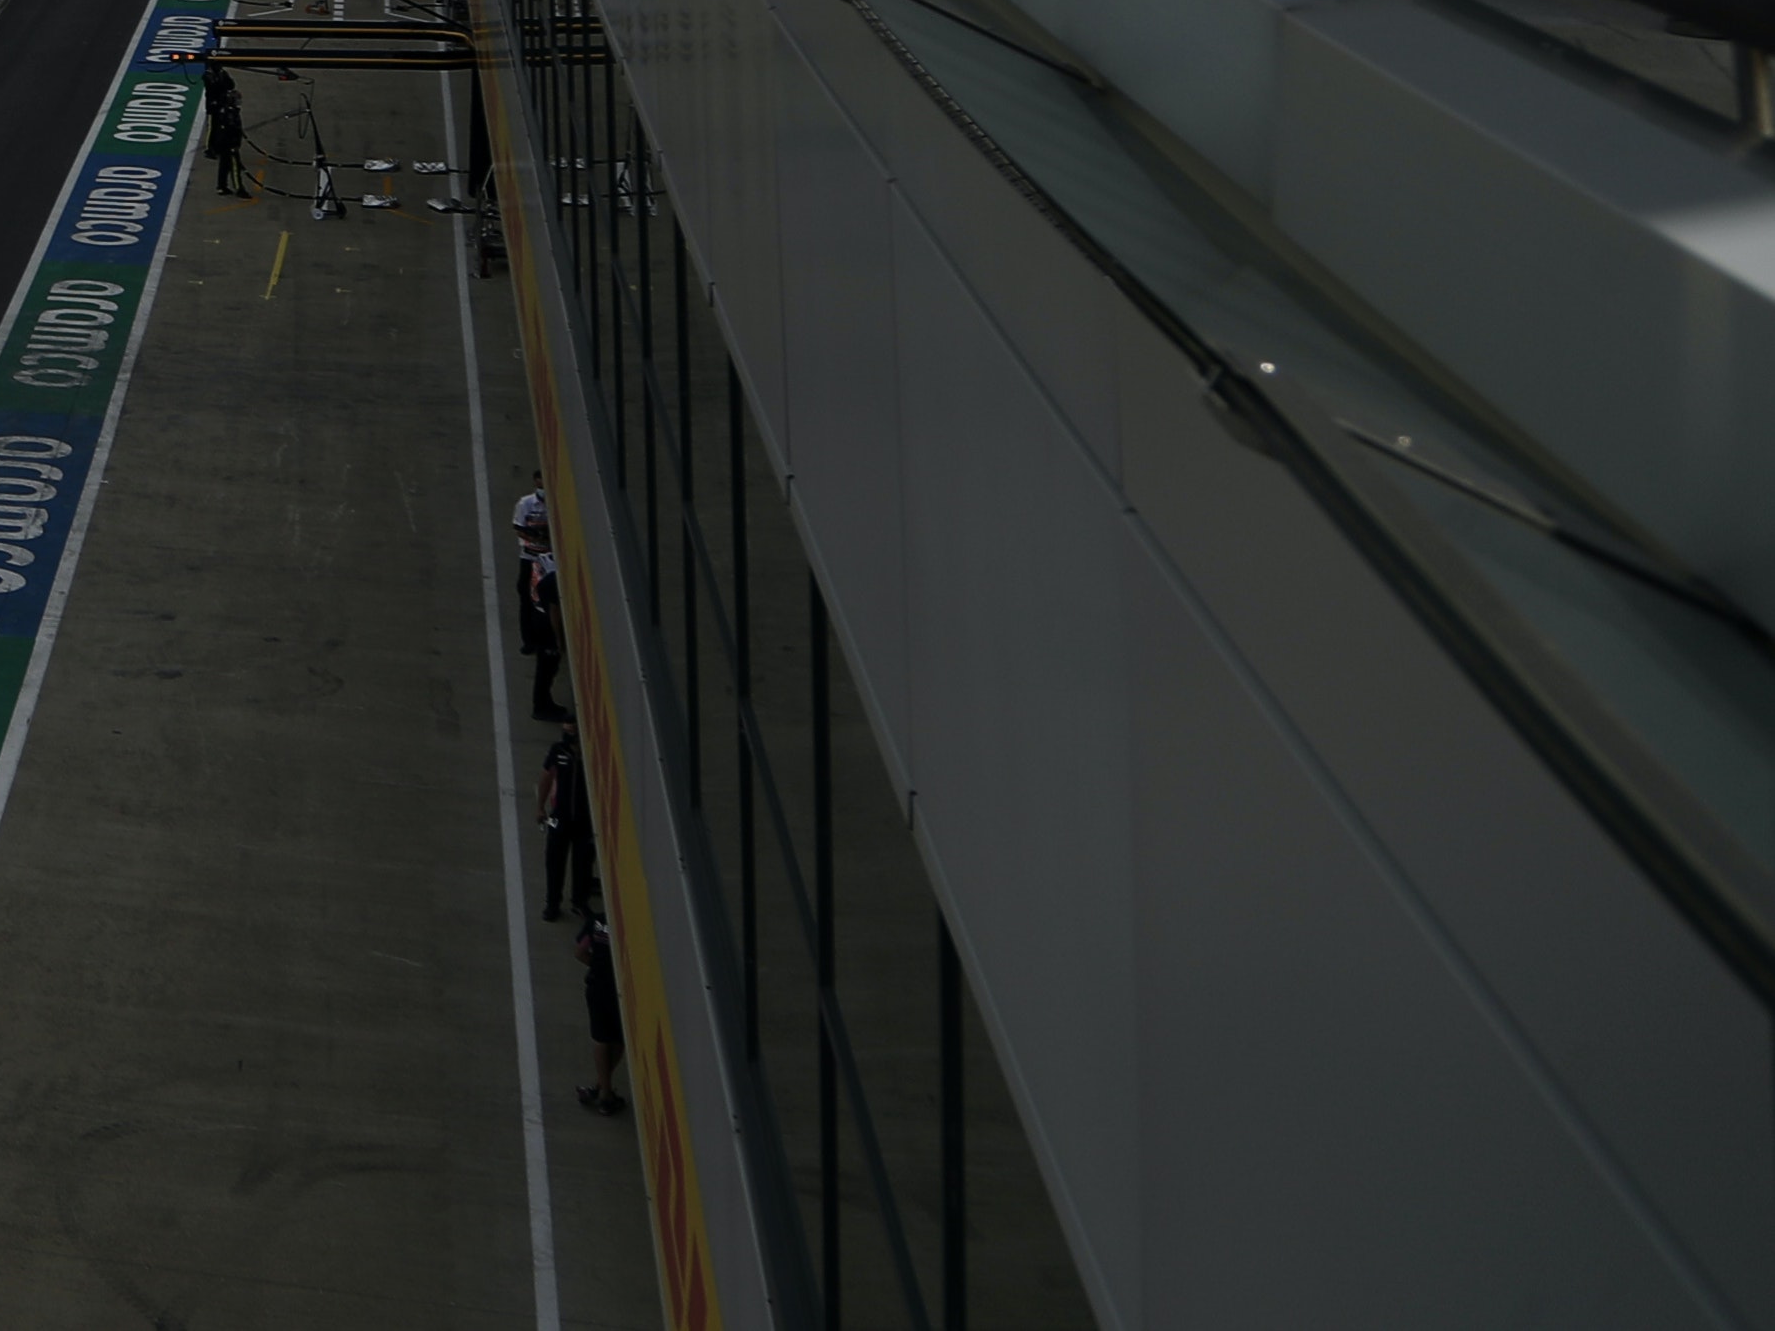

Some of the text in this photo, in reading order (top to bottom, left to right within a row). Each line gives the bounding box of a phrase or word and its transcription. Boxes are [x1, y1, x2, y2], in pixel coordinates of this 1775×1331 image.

[113, 82, 189, 143] aramco
[71, 166, 162, 246] aramco
[13, 279, 125, 389] aramco
